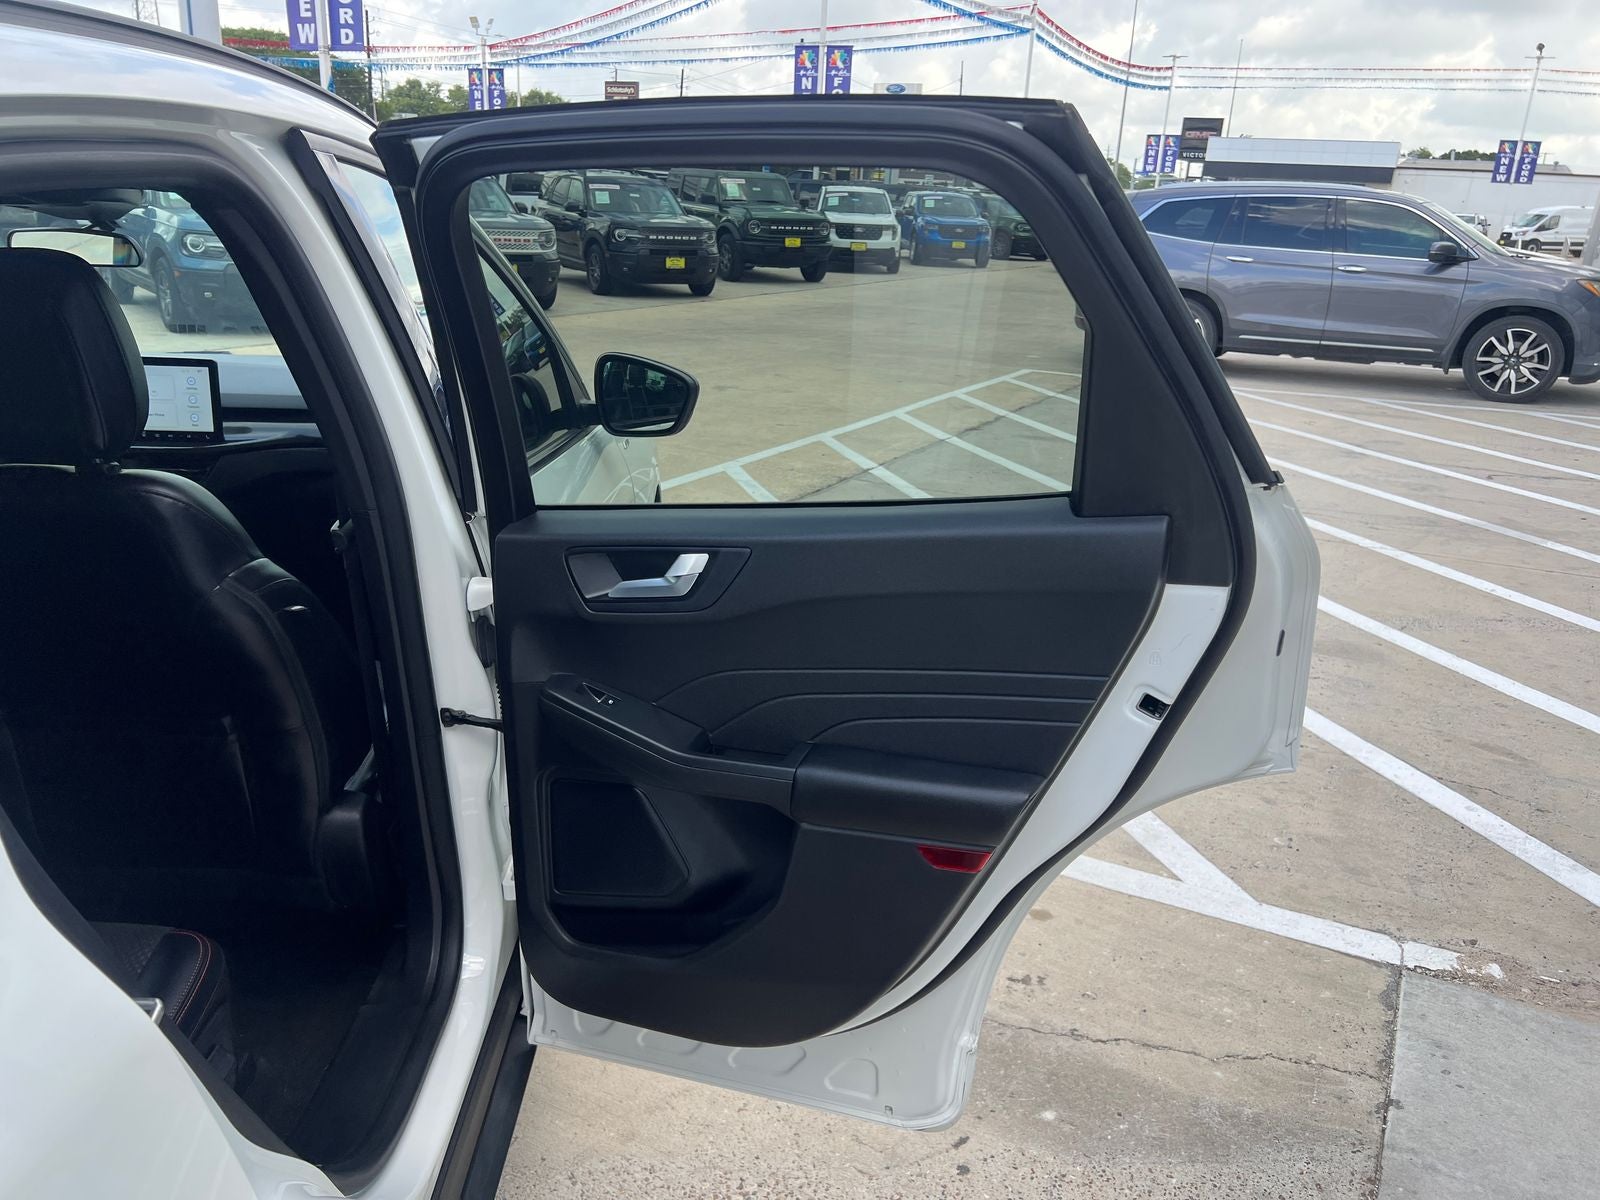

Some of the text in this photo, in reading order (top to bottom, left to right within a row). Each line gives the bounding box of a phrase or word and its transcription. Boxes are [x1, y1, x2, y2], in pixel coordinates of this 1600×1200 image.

[338, 0, 354, 44] RD
[493, 90, 502, 109] FO
[1145, 150, 1156, 171] NEW
[1164, 150, 1174, 172] FORD
[1496, 157, 1509, 182] NEW
[1520, 158, 1531, 182] FORD
